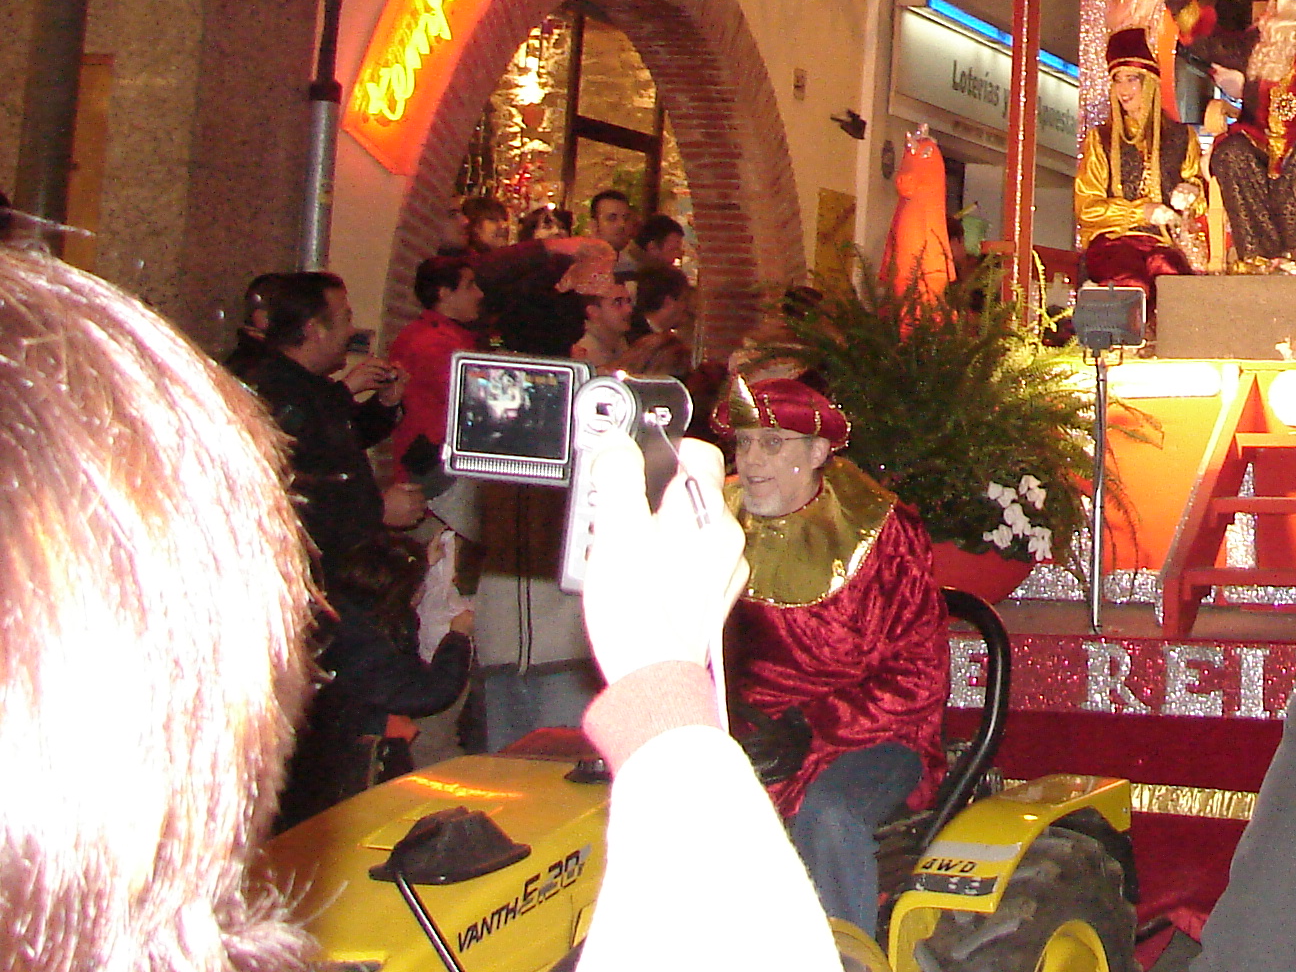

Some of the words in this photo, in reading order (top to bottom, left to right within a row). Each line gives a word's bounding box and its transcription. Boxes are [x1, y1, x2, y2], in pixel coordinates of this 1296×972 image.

[951, 59, 1001, 107] Loterías
[922, 857, 977, 873] 4WD
[457, 896, 520, 954] VANTH
